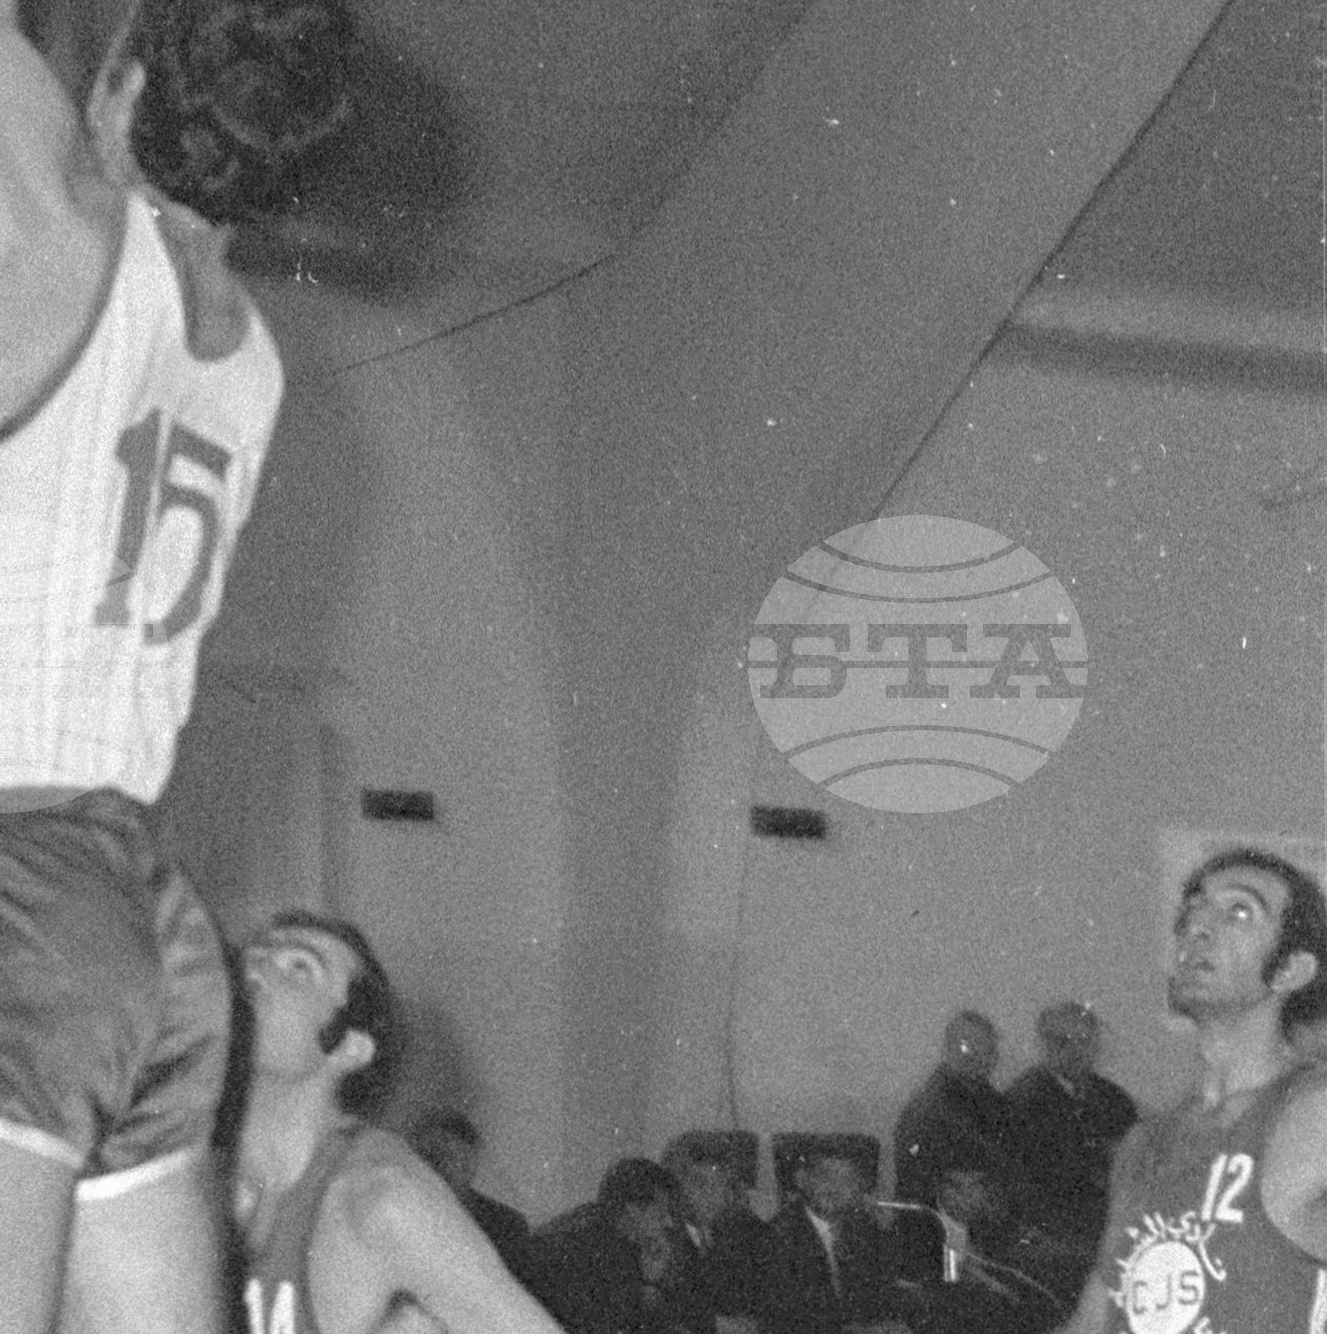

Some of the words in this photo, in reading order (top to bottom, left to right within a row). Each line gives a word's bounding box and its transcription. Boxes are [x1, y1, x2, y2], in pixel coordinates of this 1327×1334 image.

[93, 407, 232, 646] 15
[1201, 1153, 1255, 1224] 12
[1132, 1269, 1200, 1316] CJS
